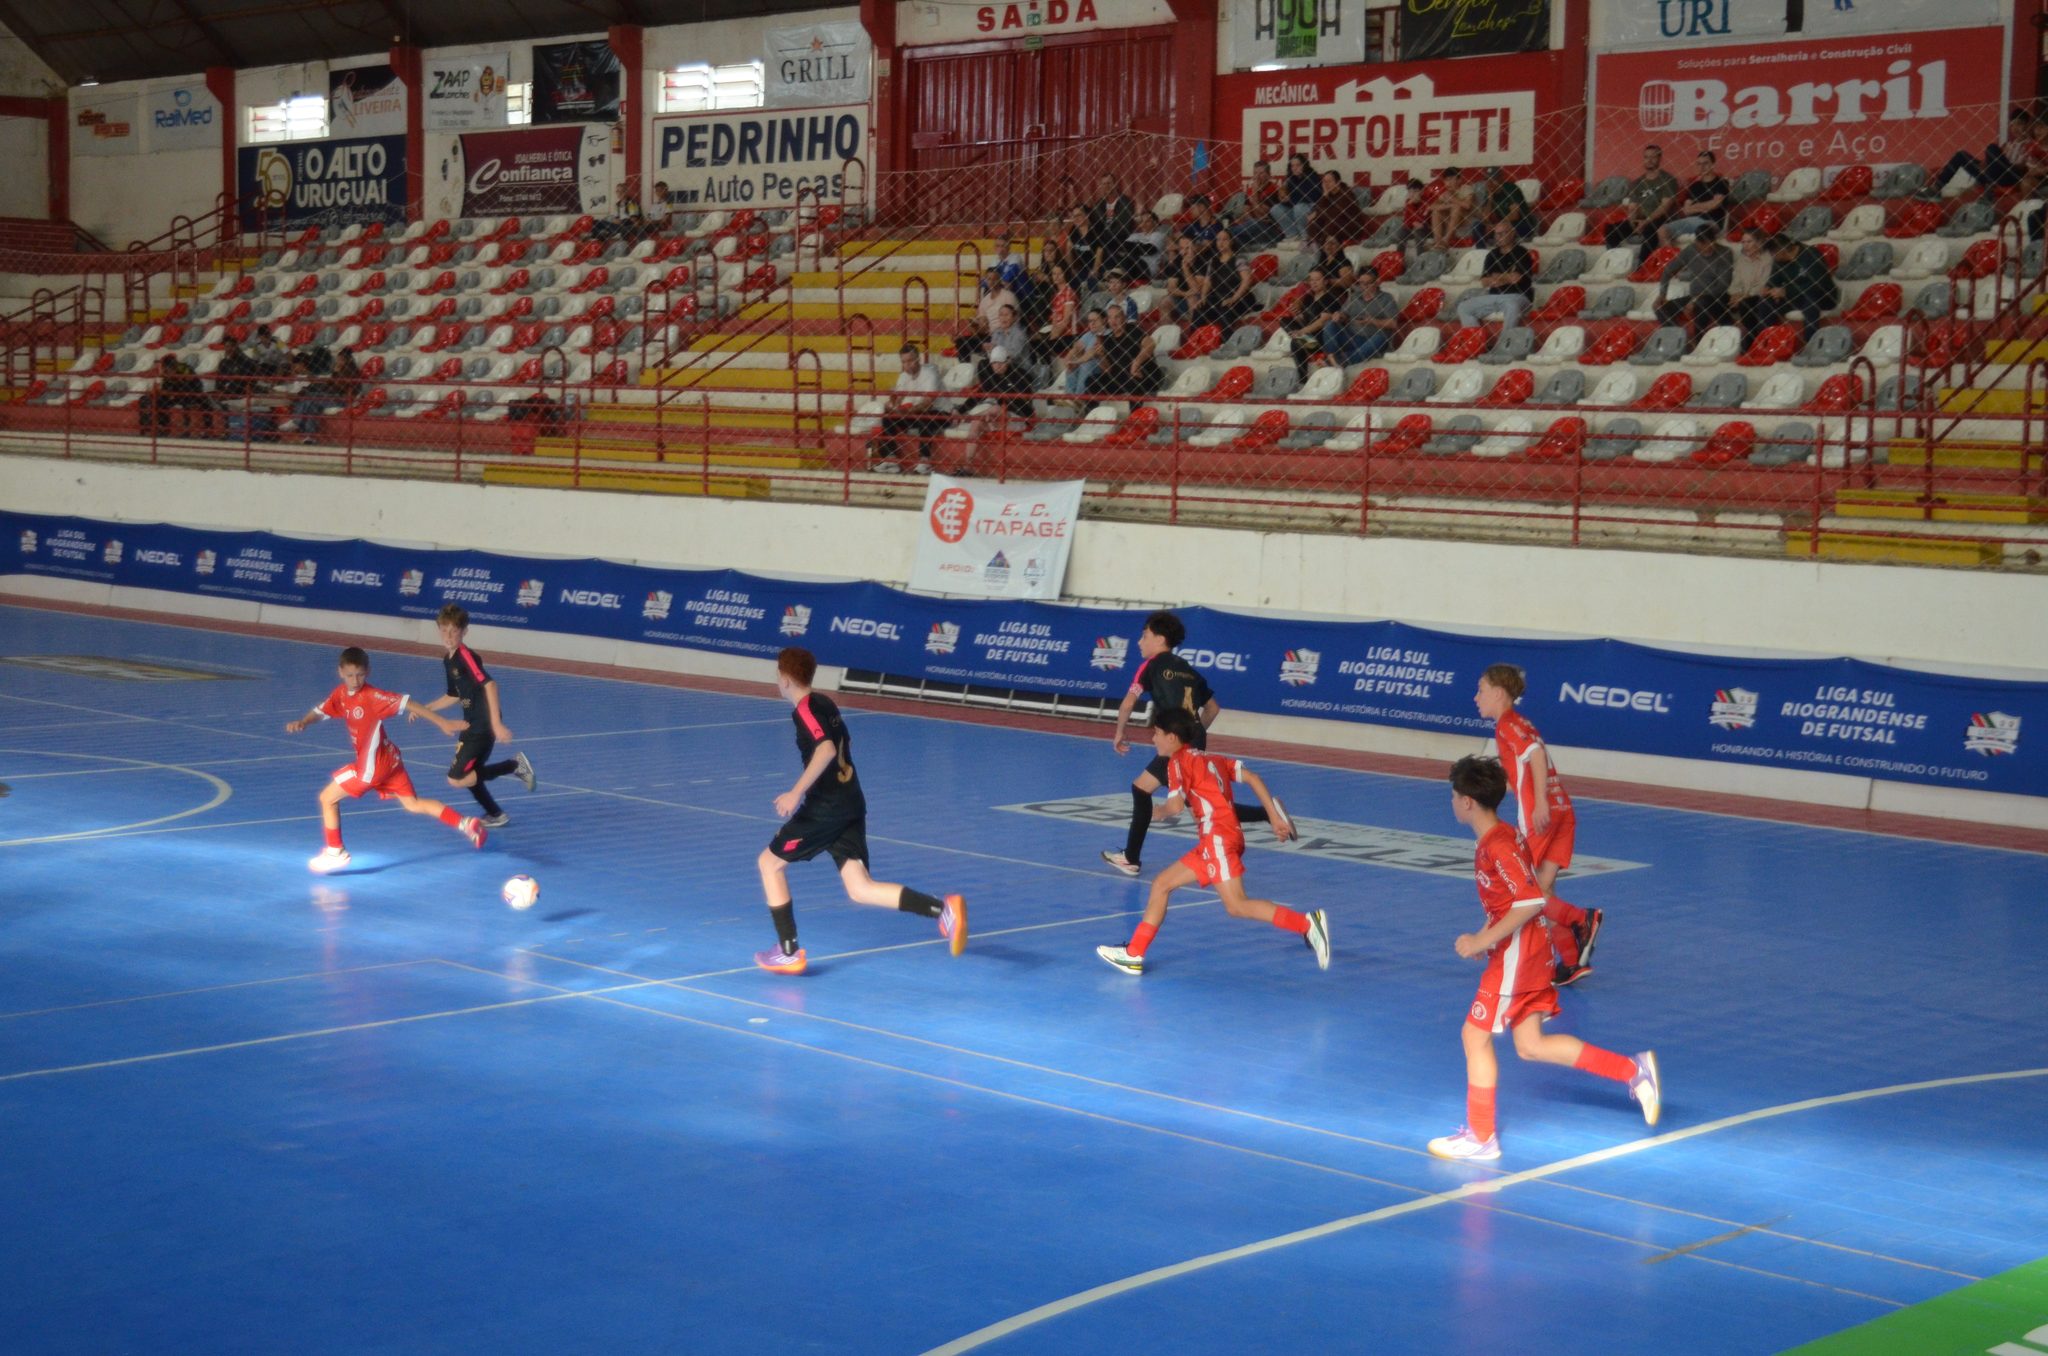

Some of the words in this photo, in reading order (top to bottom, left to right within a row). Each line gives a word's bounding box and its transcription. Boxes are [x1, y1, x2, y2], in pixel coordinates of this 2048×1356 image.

[1658, 0, 1731, 37] URI
[1677, 56, 1722, 70] Soluções
[1723, 56, 1747, 68] para
[1748, 52, 1808, 65] Serralheria
[1819, 46, 1883, 60] Construção
[1886, 43, 1912, 55] Civil
[781, 54, 855, 84] GRILL
[1254, 80, 1319, 105] MECÂNICA
[1672, 60, 1950, 131] Barril
[661, 114, 860, 168] PEDRINHO
[1259, 107, 1511, 164] BERTOLETTI
[1708, 133, 1785, 160] Ferro
[1798, 139, 1814, 156] e
[1827, 129, 1887, 161] Aço
[305, 148, 324, 180] O
[325, 143, 387, 180] ALTO
[514, 151, 547, 164] JOALHERIA
[469, 158, 573, 194] Confiança
[296, 179, 388, 208] URUGUAI
[704, 175, 754, 203] Auto
[1000, 504, 1020, 517] E.
[1030, 504, 1050, 517] C.
[135, 549, 181, 566] NEDEL
[240, 548, 258, 558] LIGA
[258, 549, 273, 560] SUL
[226, 558, 285, 573] RIOGRANDENSE
[233, 570, 245, 579] DE
[246, 570, 273, 582] FUTSAL
[452, 567, 473, 577] LIGA
[474, 569, 491, 579] SUL
[331, 569, 382, 587] NEDEL
[435, 578, 505, 593] RIOGRANDENSE
[443, 590, 456, 600] DE
[456, 591, 489, 603] FUTSAL
[560, 589, 622, 609] NEDEL
[705, 589, 730, 602] LIGA
[731, 592, 750, 605] SUL
[685, 600, 766, 619] RIOGRANDENSE
[694, 615, 709, 626] DE
[710, 615, 748, 631] FUTSAL
[830, 616, 901, 641] NEDEL
[999, 621, 1028, 634] LIGA
[1030, 624, 1051, 637] SUL
[974, 634, 1071, 653] RIOGRANDENSE
[986, 649, 1003, 660] DE
[1004, 650, 1049, 665] FUTSAL
[1366, 646, 1401, 662] LIGA
[1403, 650, 1431, 665] SUL
[925, 666, 966, 678] HONRANDO
[974, 670, 1007, 682] HISTÓRIA
[1014, 675, 1066, 688] CONSTRUINDO
[1076, 681, 1108, 691] FUTURO
[1338, 660, 1455, 685] RIOGRANDENSE
[1353, 678, 1374, 693] DE
[1375, 680, 1431, 698] FUTSAL
[1559, 681, 1670, 713] NEDEL
[1815, 686, 1858, 704] LIGA
[1860, 690, 1896, 708] SUL
[1281, 698, 1332, 712] HONRANDO
[1341, 701, 1380, 716] HISTÓRIA
[1388, 707, 1452, 725] CONSTRUINDO
[1781, 701, 1928, 730] RIOGRANDENSE
[1801, 722, 1826, 737] DE
[1827, 724, 1896, 744] FUTSAL
[1711, 743, 1773, 758] HONRANDO
[1774, 749, 1783, 758] A
[1785, 748, 1832, 764] HISTÓRIA
[1843, 755, 1925, 775] CONSTRUINDO
[1927, 766, 1939, 776] O
[1941, 766, 1988, 781] FUTURO
